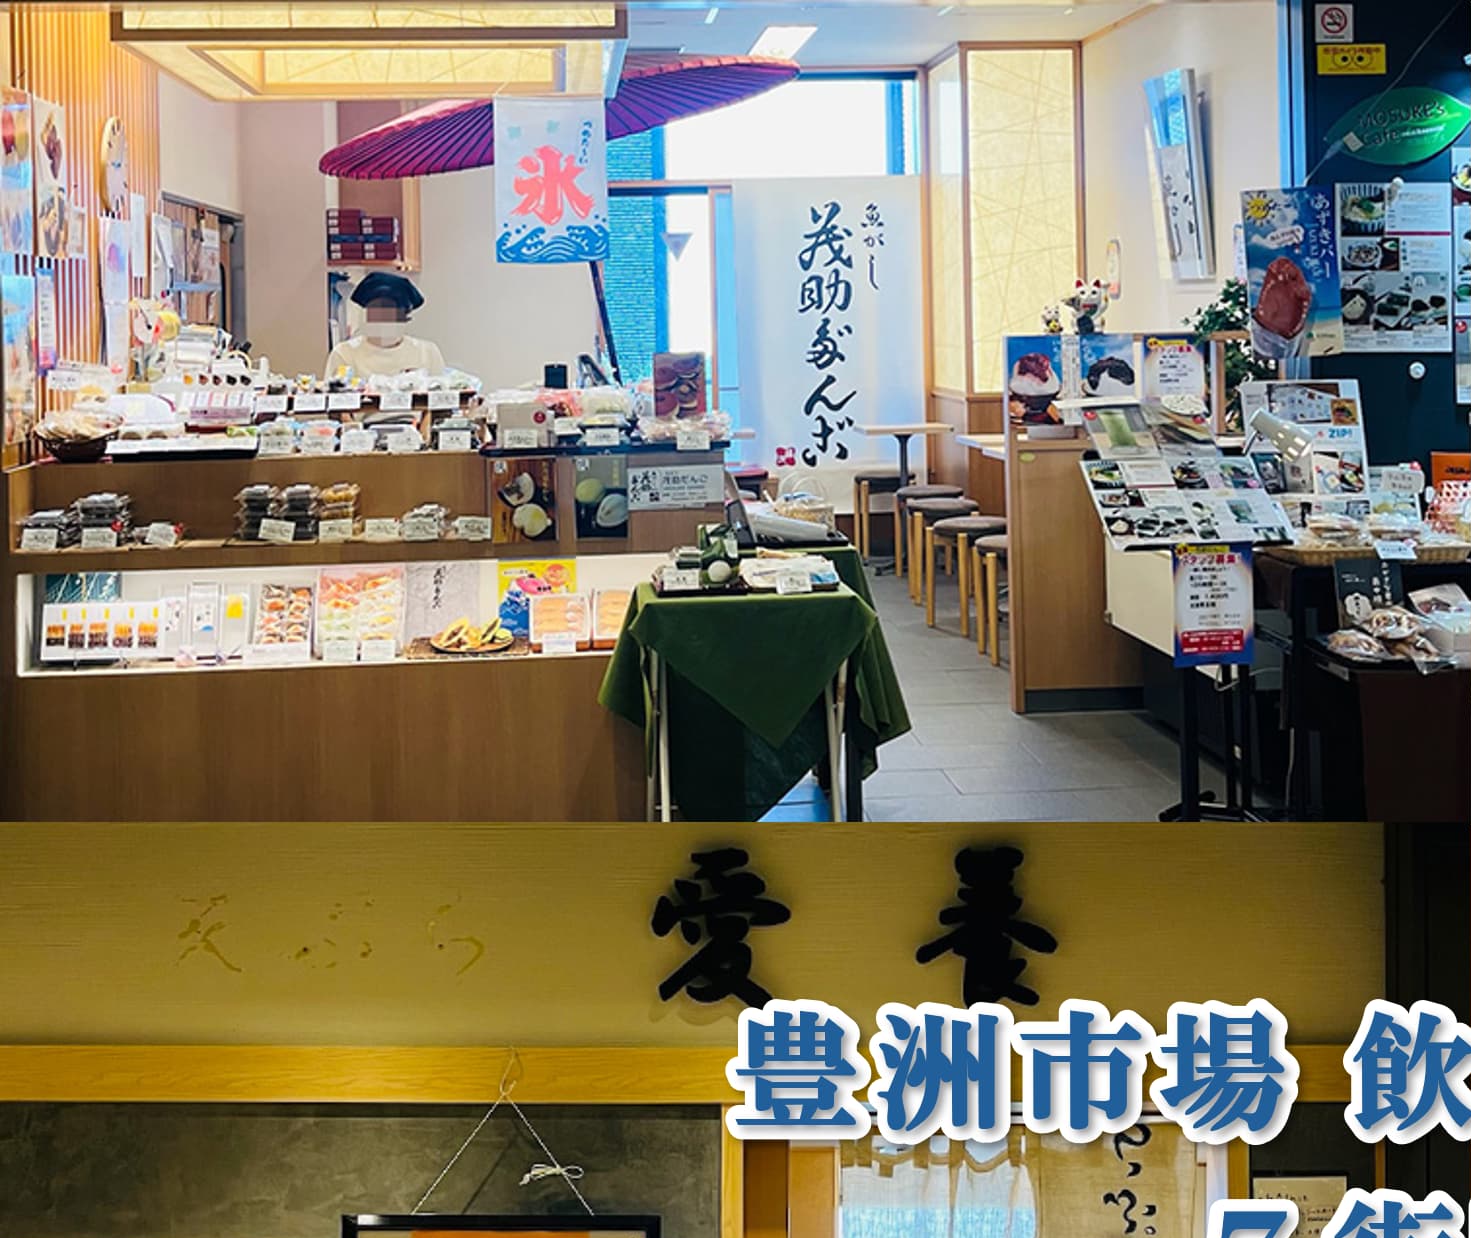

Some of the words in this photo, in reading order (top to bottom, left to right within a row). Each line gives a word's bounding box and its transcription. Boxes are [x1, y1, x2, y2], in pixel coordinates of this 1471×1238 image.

[509, 145, 596, 226] 氷
[861, 203, 885, 290] 魚がし
[1310, 191, 1335, 279] あずきバー
